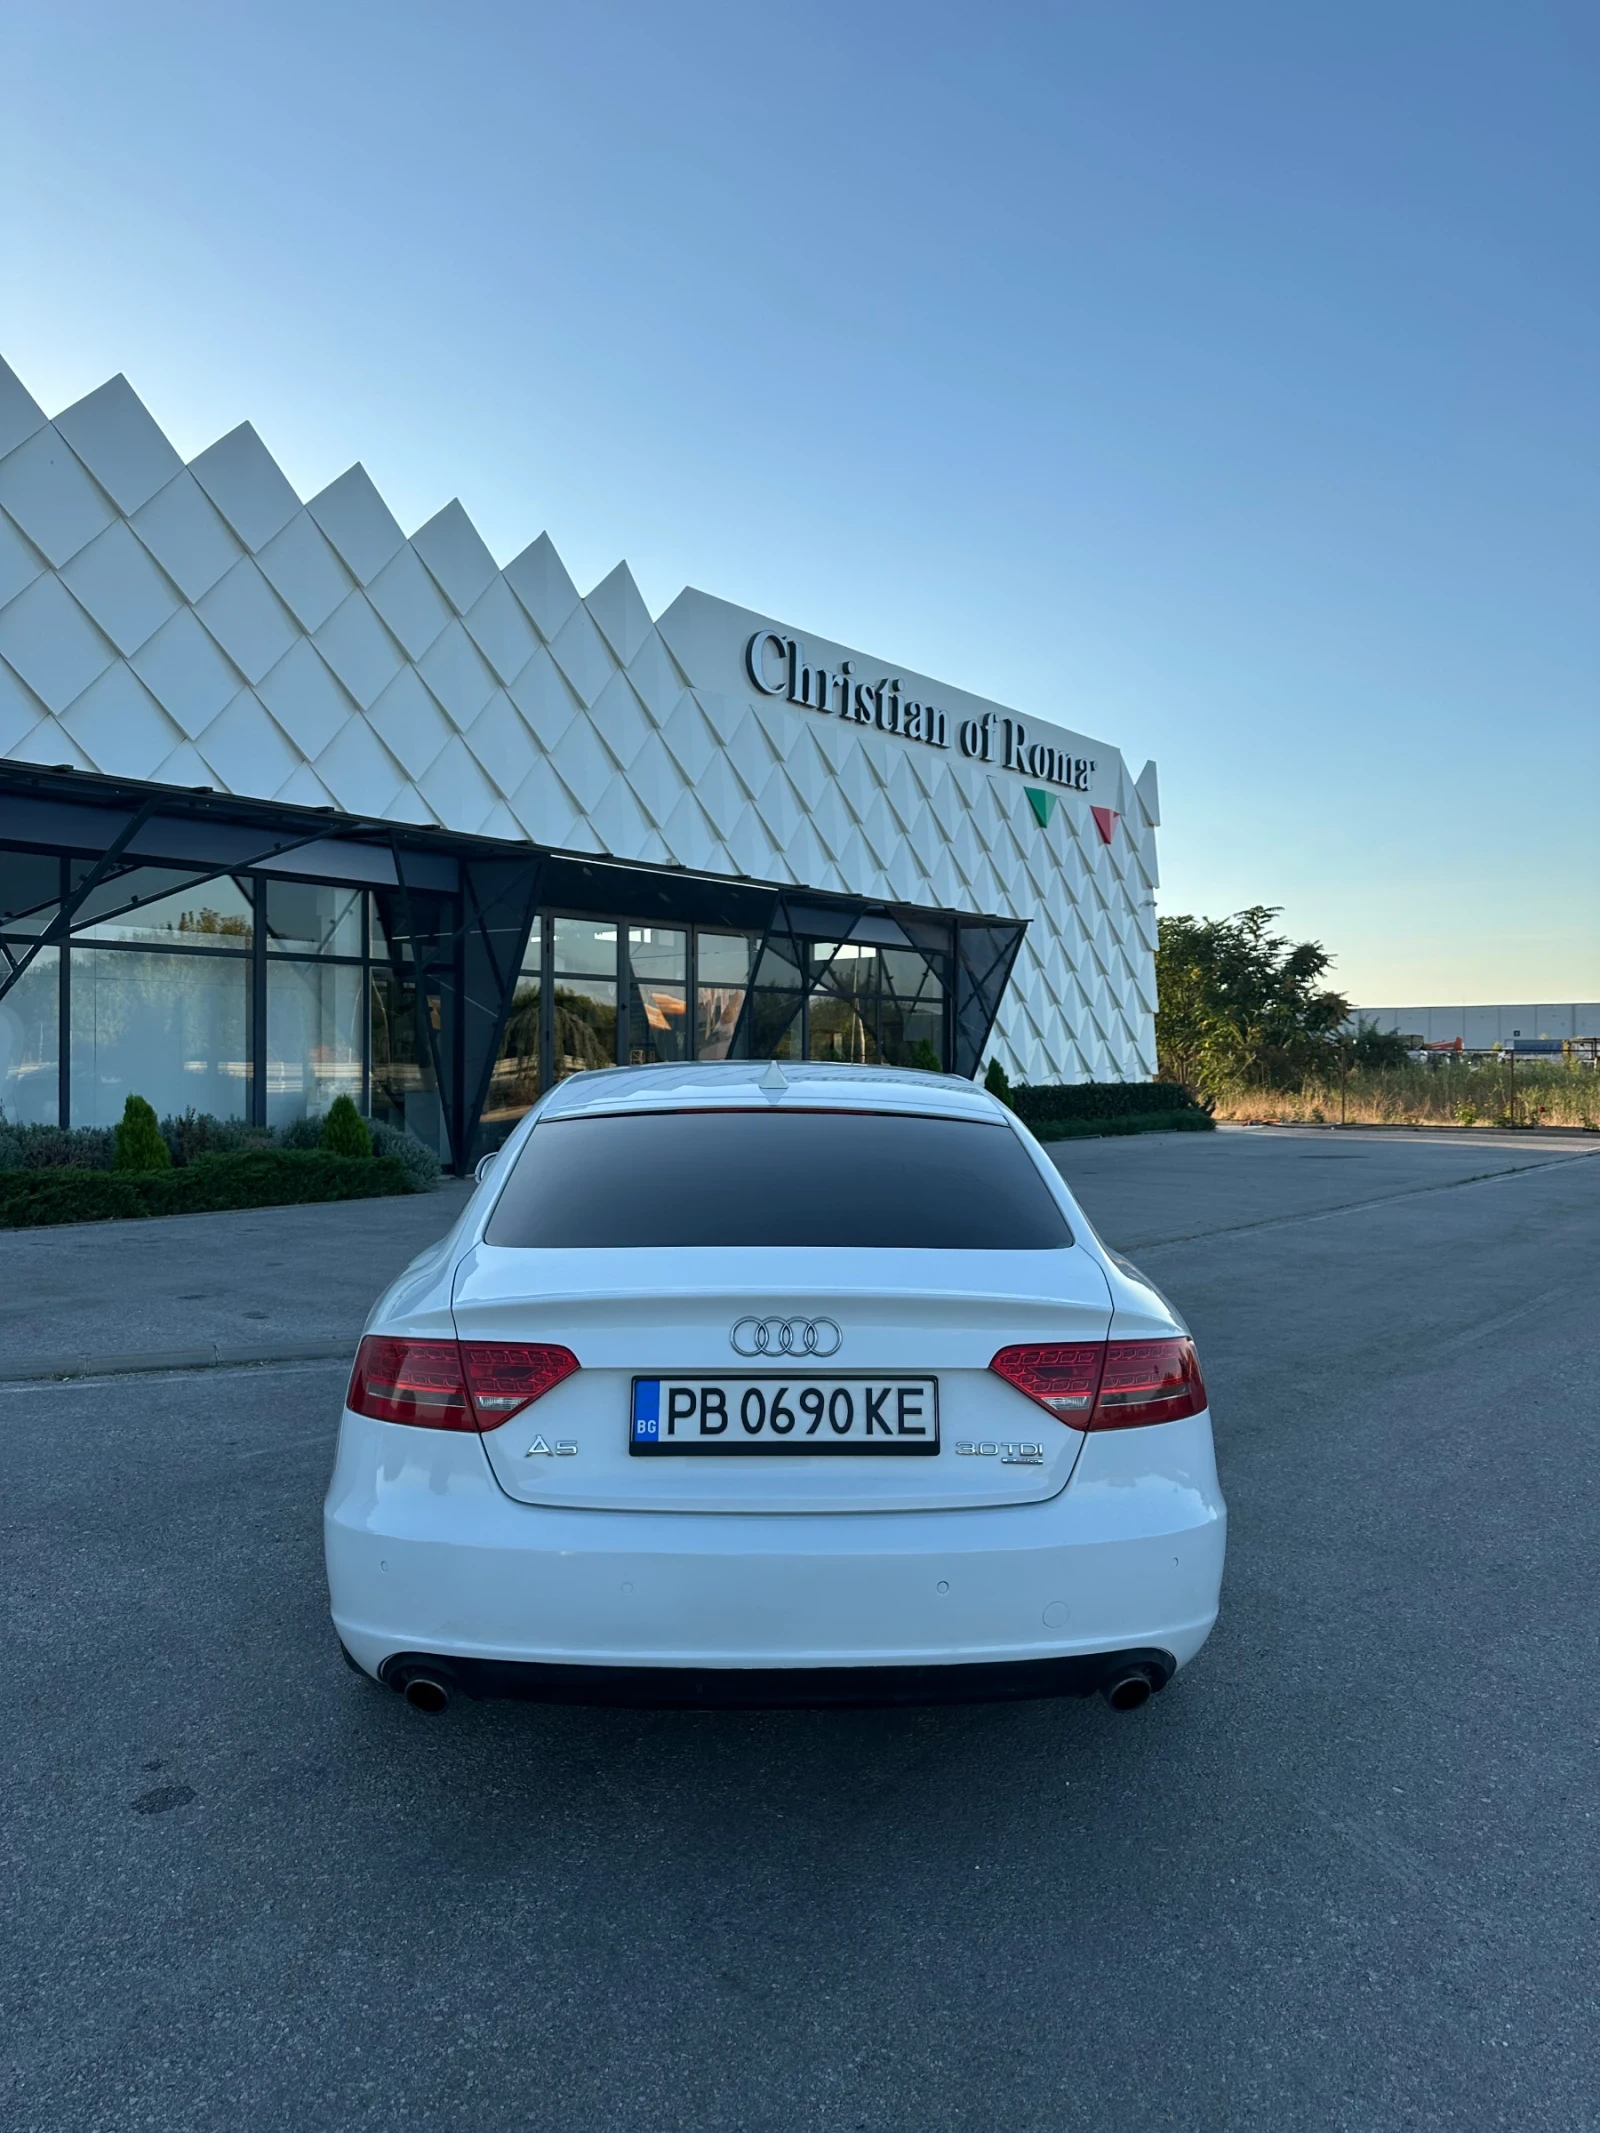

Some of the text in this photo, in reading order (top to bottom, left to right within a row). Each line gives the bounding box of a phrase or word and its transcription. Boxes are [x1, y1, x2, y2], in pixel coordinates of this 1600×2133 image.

[746, 630, 1094, 791] Christian of Roma
[667, 1387, 926, 1435] PB 0690 KE
[636, 1419, 657, 1434] BG
[525, 1434, 579, 1458] A5
[1001, 1441, 1044, 1457] TDI
